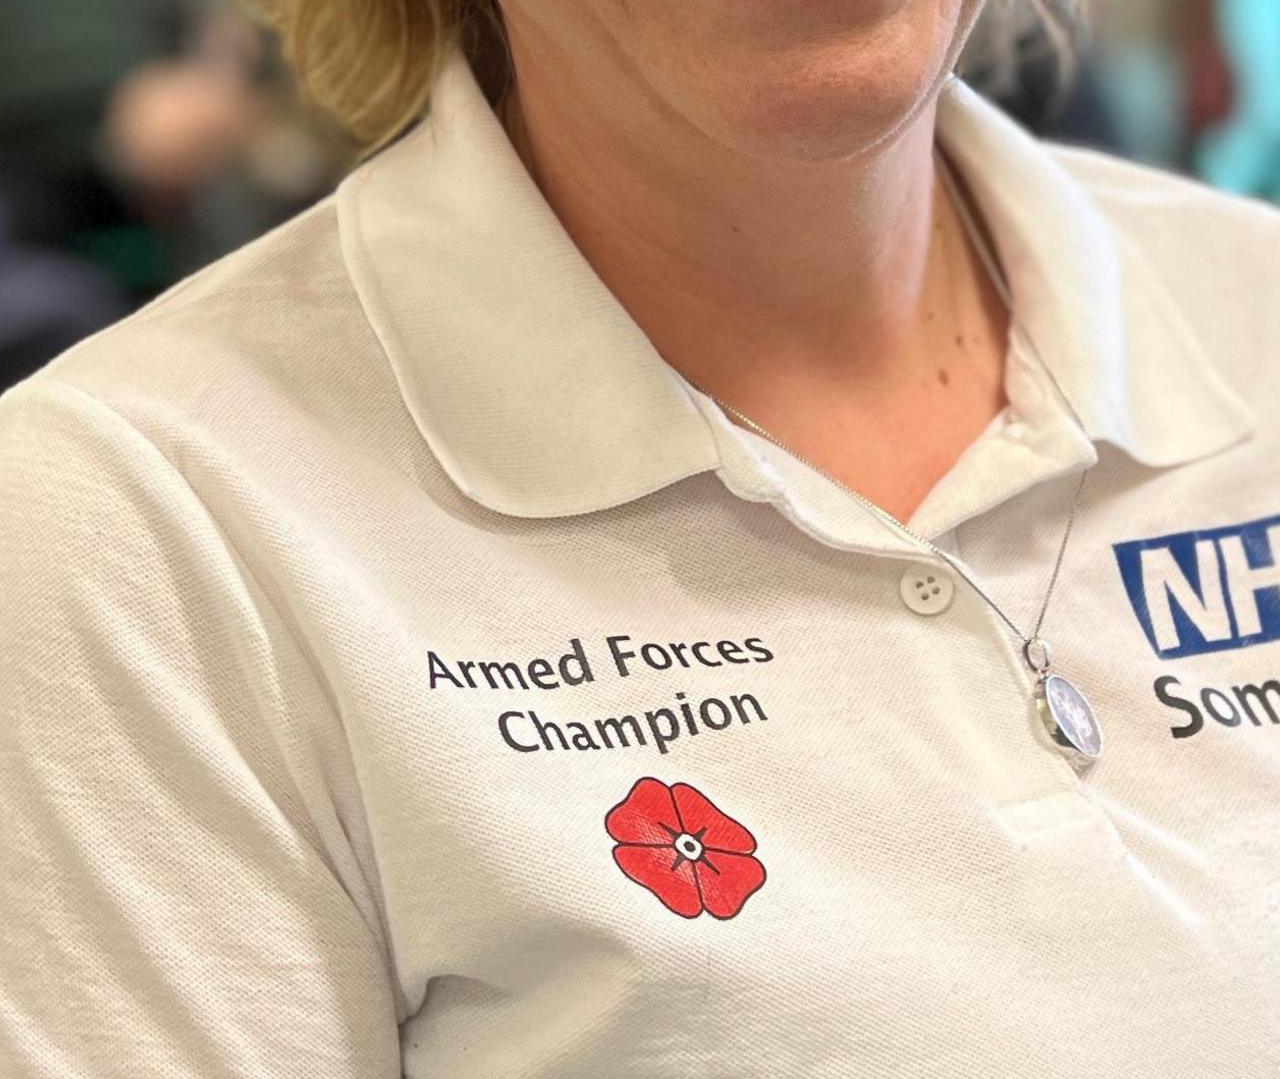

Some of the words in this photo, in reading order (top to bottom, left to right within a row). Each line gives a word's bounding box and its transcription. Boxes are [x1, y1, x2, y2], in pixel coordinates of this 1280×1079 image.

[426, 637, 595, 690] Armed
[606, 634, 775, 678] Forces
[497, 691, 769, 755] Champion
